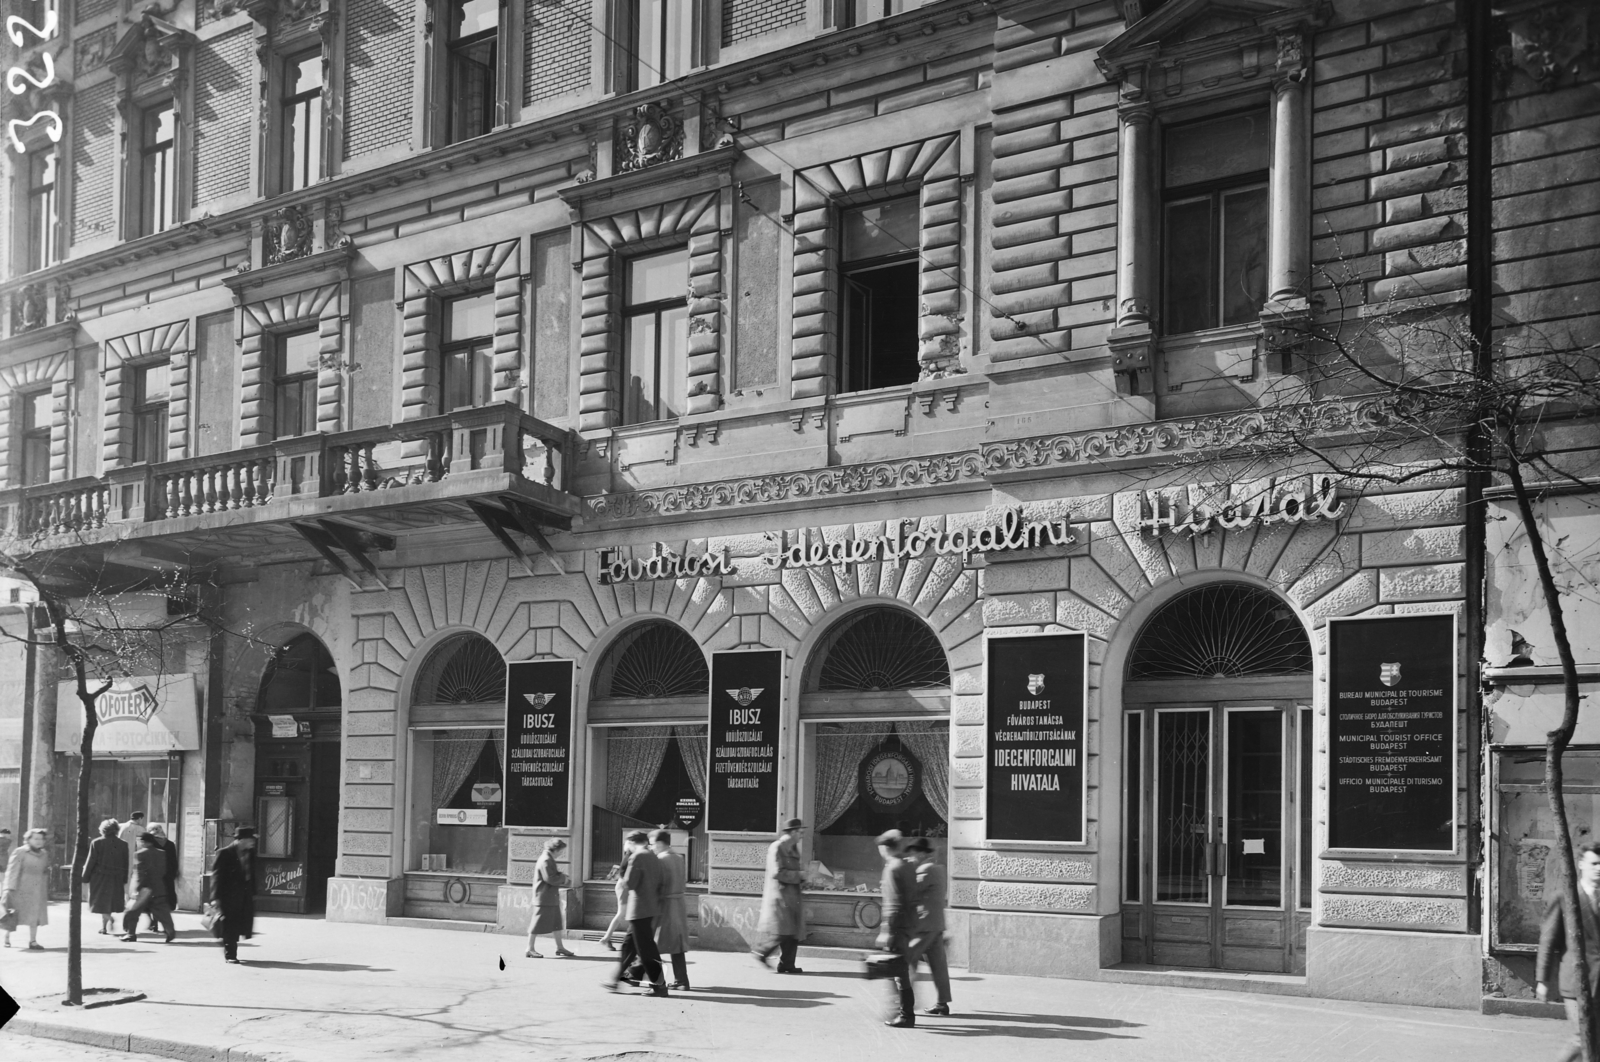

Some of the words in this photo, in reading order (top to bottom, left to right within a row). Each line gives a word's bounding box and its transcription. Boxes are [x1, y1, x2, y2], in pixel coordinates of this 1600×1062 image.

[1339, 691, 1363, 699] BUREAU
[1364, 690, 1398, 698] MUNICIPAL
[1399, 690, 1408, 698] DE
[1408, 689, 1443, 697] TOURISME
[1018, 700, 1051, 710] BUDAPEST
[1370, 698, 1408, 706] BUDAPEST
[523, 714, 555, 728] IBUSZ
[730, 708, 761, 725] IBUSZ
[1006, 714, 1035, 726] FŐVÁROS
[1035, 713, 1064, 726] TANÁCSA
[1370, 720, 1408, 728] БУДАПЕШТ
[994, 728, 1076, 742] VÉGREHAJTÓBIZOTTSÁGÁNAK
[1338, 734, 1378, 742] MUNICIPAL
[1379, 734, 1411, 742] TOURIST
[1370, 742, 1408, 750] BUDAPEST
[994, 748, 1076, 767] IDEGENFORGALMI
[1374, 756, 1442, 764] FREMDENVERKEHRSAMT
[1370, 764, 1408, 772] BUDAPEST
[1010, 774, 1060, 791] HIVATALA
[874, 795, 903, 805] BUDAPEST
